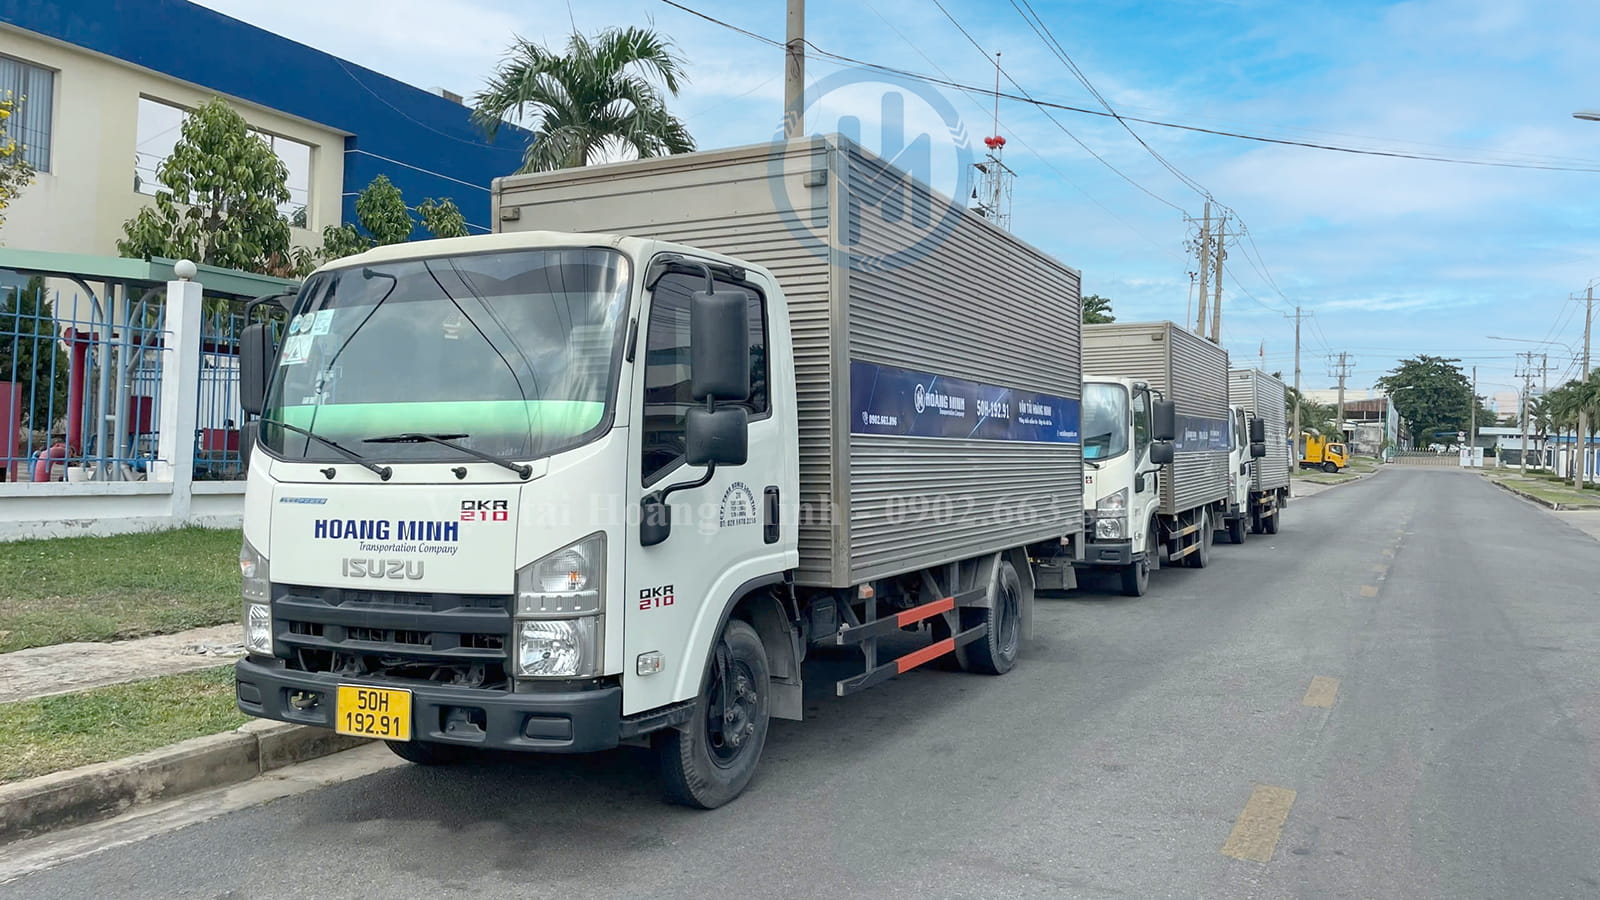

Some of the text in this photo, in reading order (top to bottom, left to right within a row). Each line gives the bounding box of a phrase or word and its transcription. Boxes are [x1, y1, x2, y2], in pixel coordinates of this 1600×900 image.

[977, 399, 1010, 420] 50H-192.91
[461, 500, 508, 510] QKR
[460, 511, 508, 521] 210
[314, 519, 459, 542] HOANG MINH
[359, 541, 458, 556] Transportation Company
[342, 558, 424, 580] ISUZU
[639, 584, 674, 598] QKR
[639, 596, 674, 610] 210
[357, 690, 389, 713] 50H
[346, 714, 400, 737] 192.91
